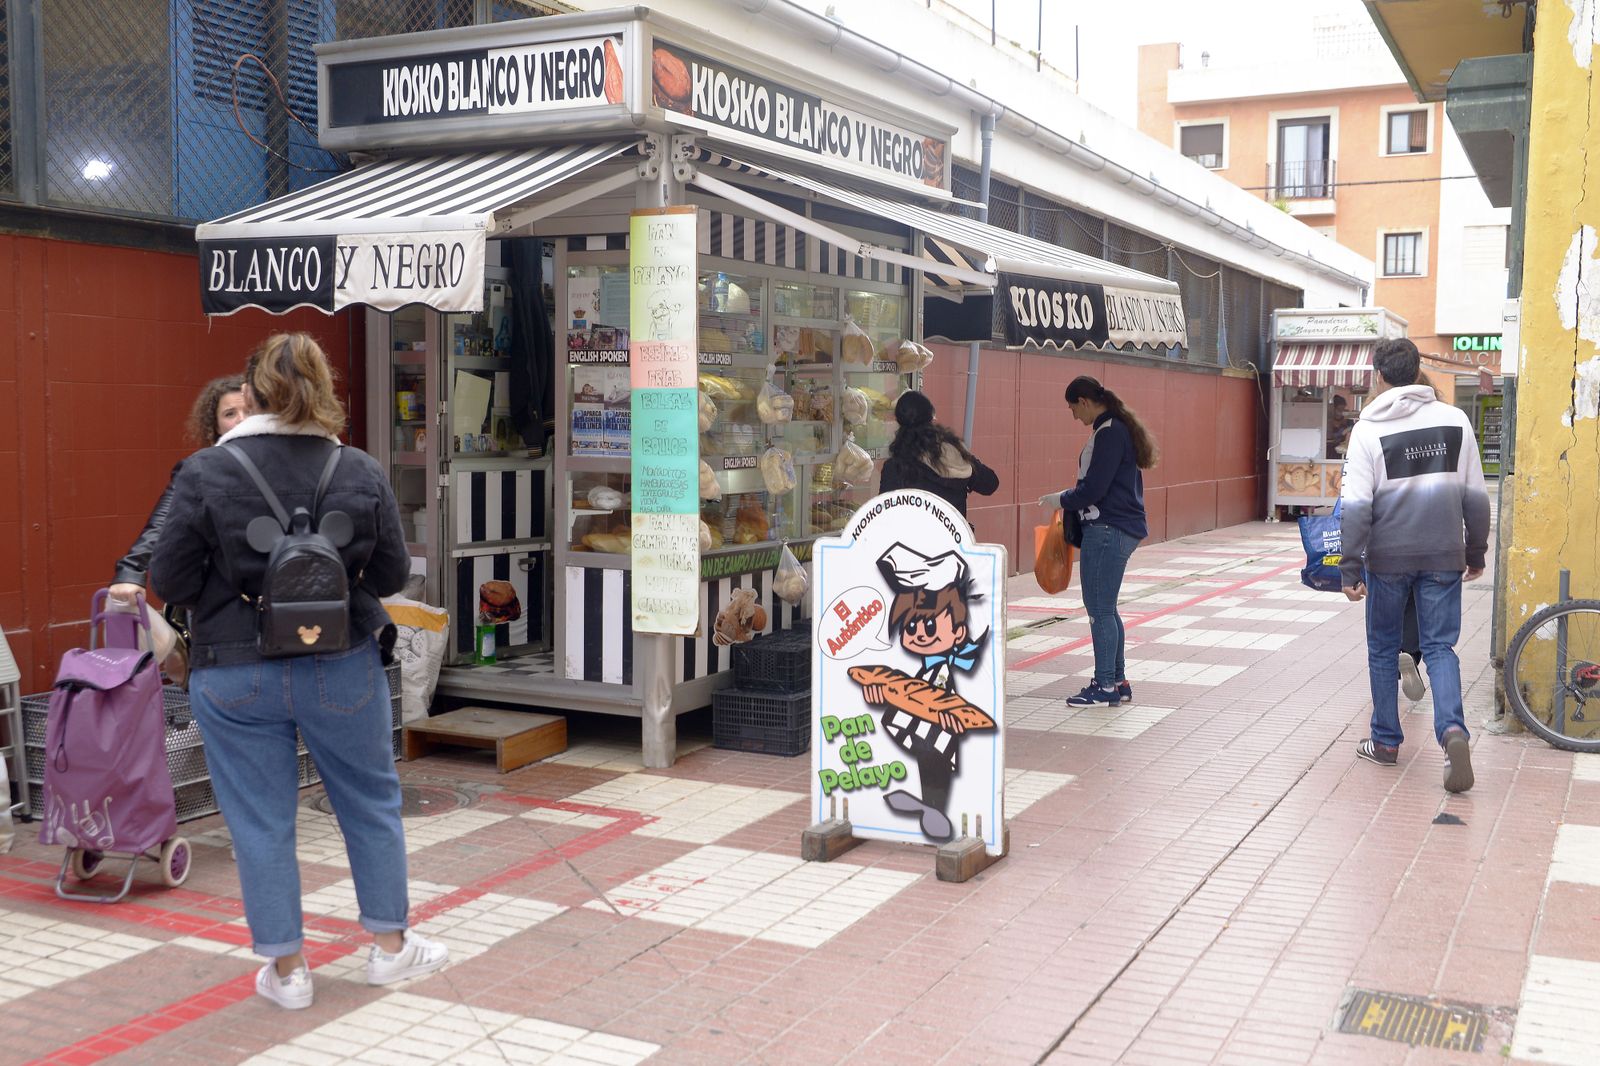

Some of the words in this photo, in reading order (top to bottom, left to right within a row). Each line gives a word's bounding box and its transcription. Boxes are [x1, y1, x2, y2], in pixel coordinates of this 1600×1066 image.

[383, 62, 444, 117] KIOSKO
[447, 54, 520, 111] BLANCO
[523, 53, 536, 103] Y
[541, 45, 605, 102] NEGRO
[691, 62, 770, 134] KIOSKO
[775, 92, 851, 158] BLANCO
[856, 120, 867, 162] Y
[870, 125, 924, 180] NEGRO
[208, 246, 322, 293] BLANCO
[336, 245, 359, 290] Y
[370, 241, 466, 290] NEGRO
[1009, 285, 1094, 331] KIOSKO
[1105, 294, 1146, 332] BLANCO
[569, 350, 599, 362] ENGLISH
[600, 350, 628, 362] SPOKEN
[641, 392, 693, 410] BOLSAS
[1405, 442, 1447, 453] HOLLISTER
[1406, 450, 1447, 460] CALIFORNIA
[852, 503, 883, 541] KIOSKO
[884, 495, 923, 510] BLANCO
[924, 500, 932, 512] Y
[931, 506, 962, 544] NEGRO
[833, 600, 852, 622] El
[826, 599, 883, 656] Auténtico
[820, 713, 875, 742] Pan
[839, 736, 873, 763] de
[818, 760, 907, 796] Pelayo
